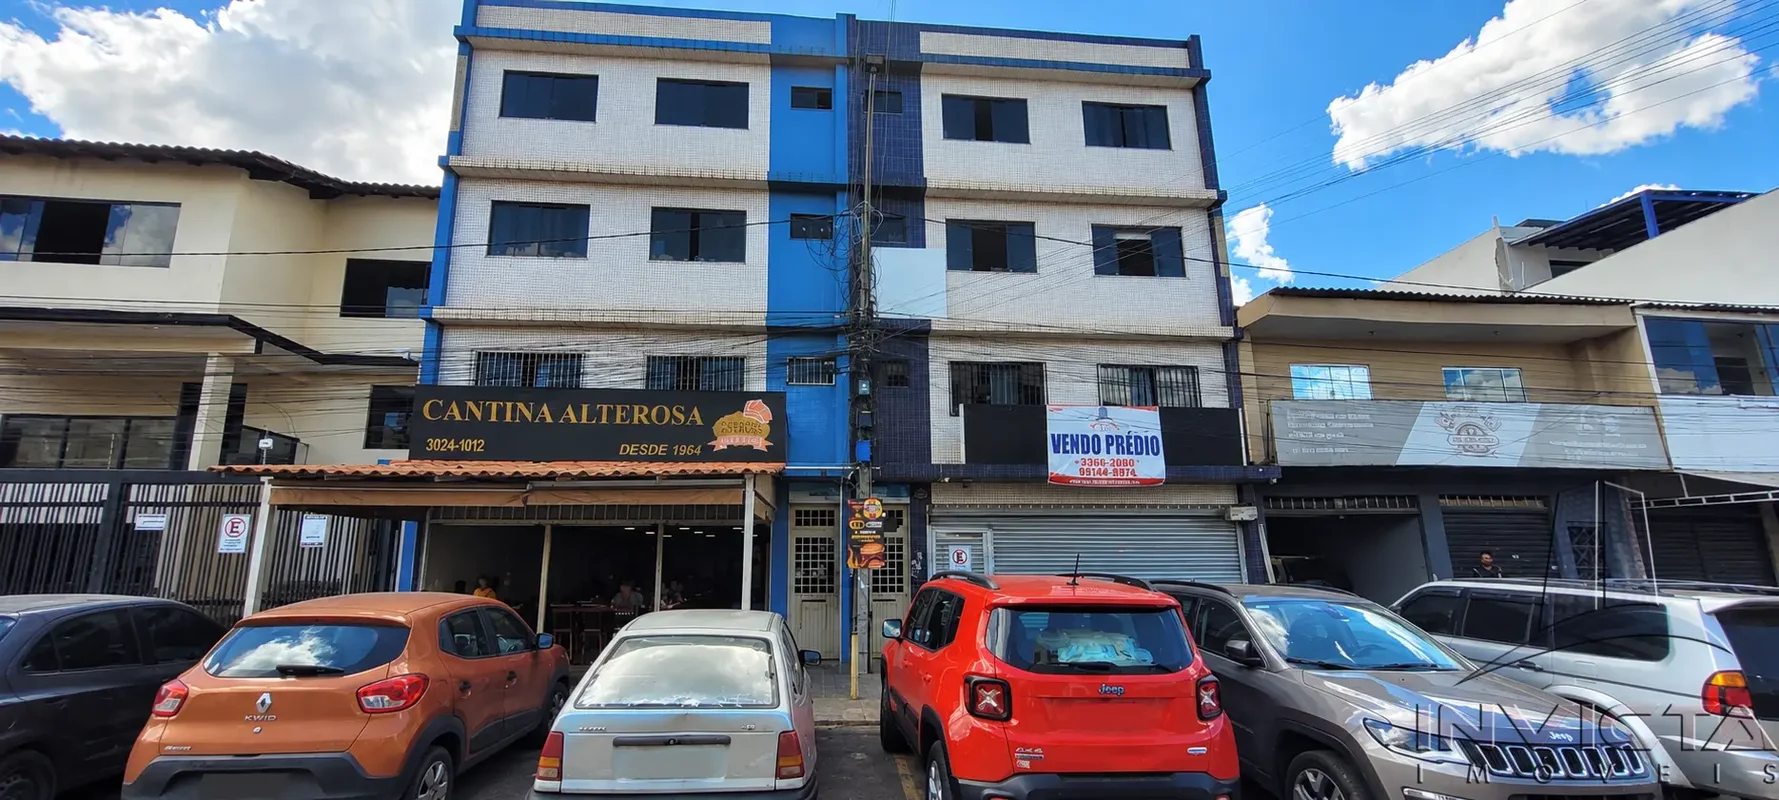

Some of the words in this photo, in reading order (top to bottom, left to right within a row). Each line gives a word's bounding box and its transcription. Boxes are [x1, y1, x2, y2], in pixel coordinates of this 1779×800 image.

[422, 399, 554, 423] CANTINA
[559, 403, 704, 426] ALTEROSA
[426, 438, 485, 452] 3024-1012
[619, 443, 668, 456] DESDE
[672, 444, 702, 456] 1964
[1050, 433, 1101, 455] VENDO
[1105, 431, 1161, 457] PRÉDIO
[230, 521, 242, 534] E
